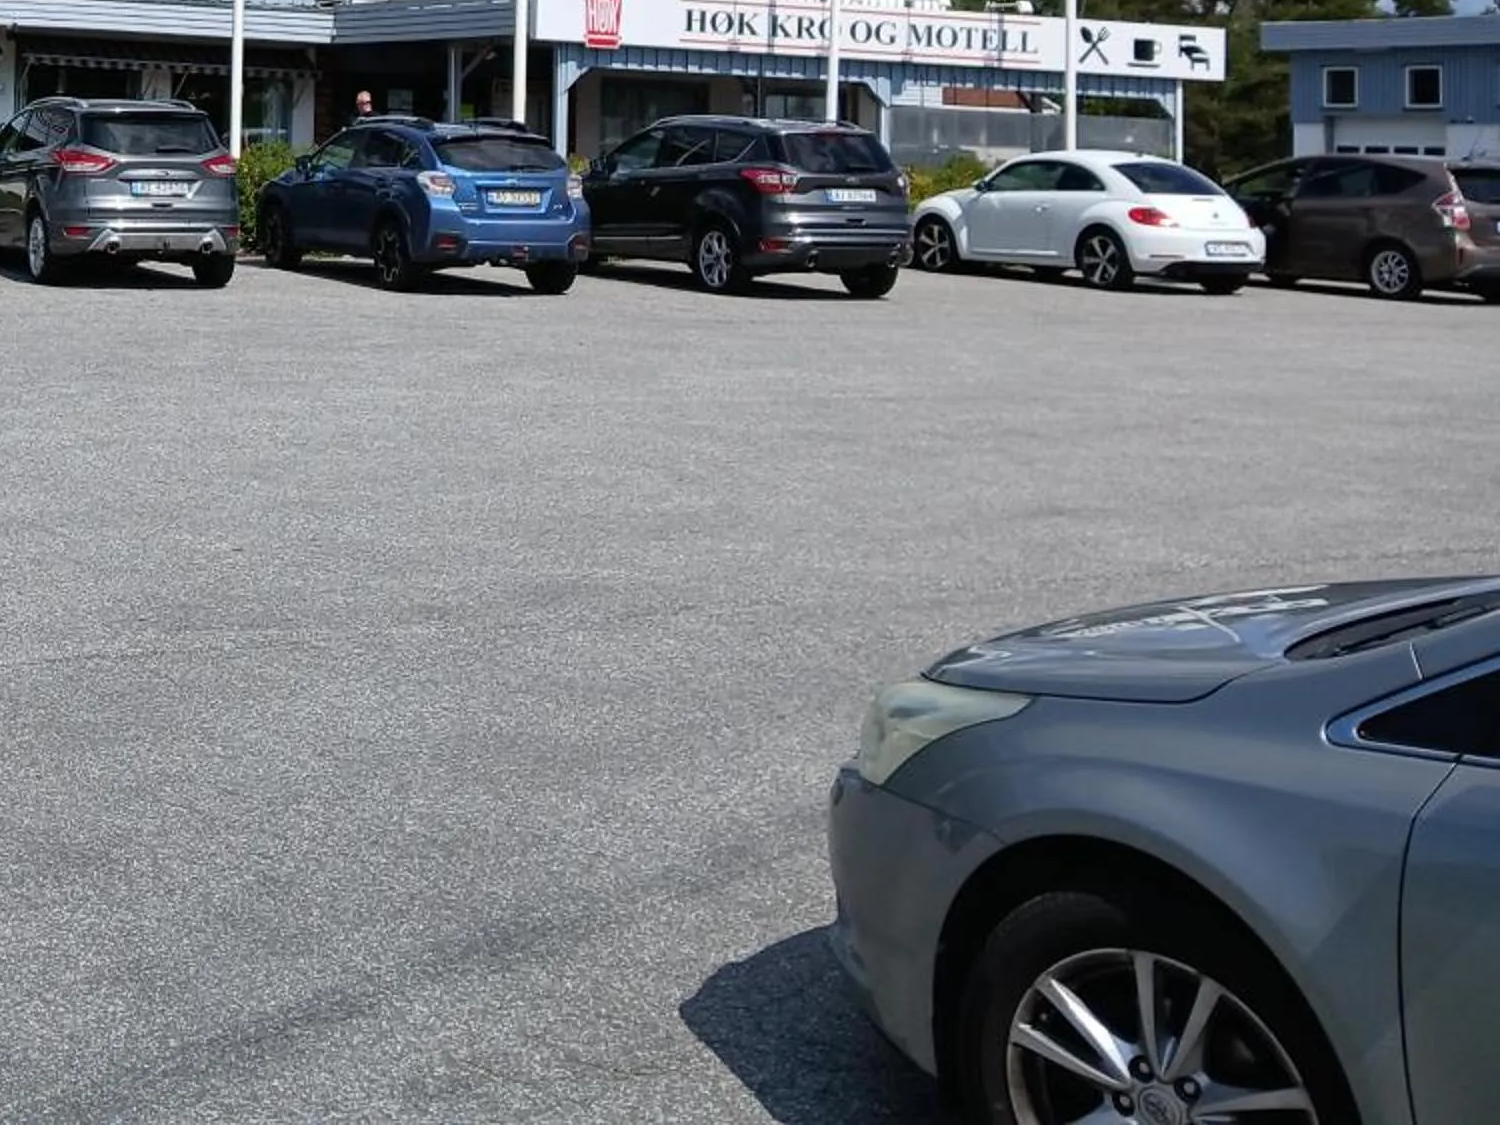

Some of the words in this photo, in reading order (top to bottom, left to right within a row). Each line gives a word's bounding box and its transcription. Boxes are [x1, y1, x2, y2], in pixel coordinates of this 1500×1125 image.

[685, 8, 759, 37] HØK
[850, 19, 897, 46] OG
[907, 23, 1039, 54] MOTELL
